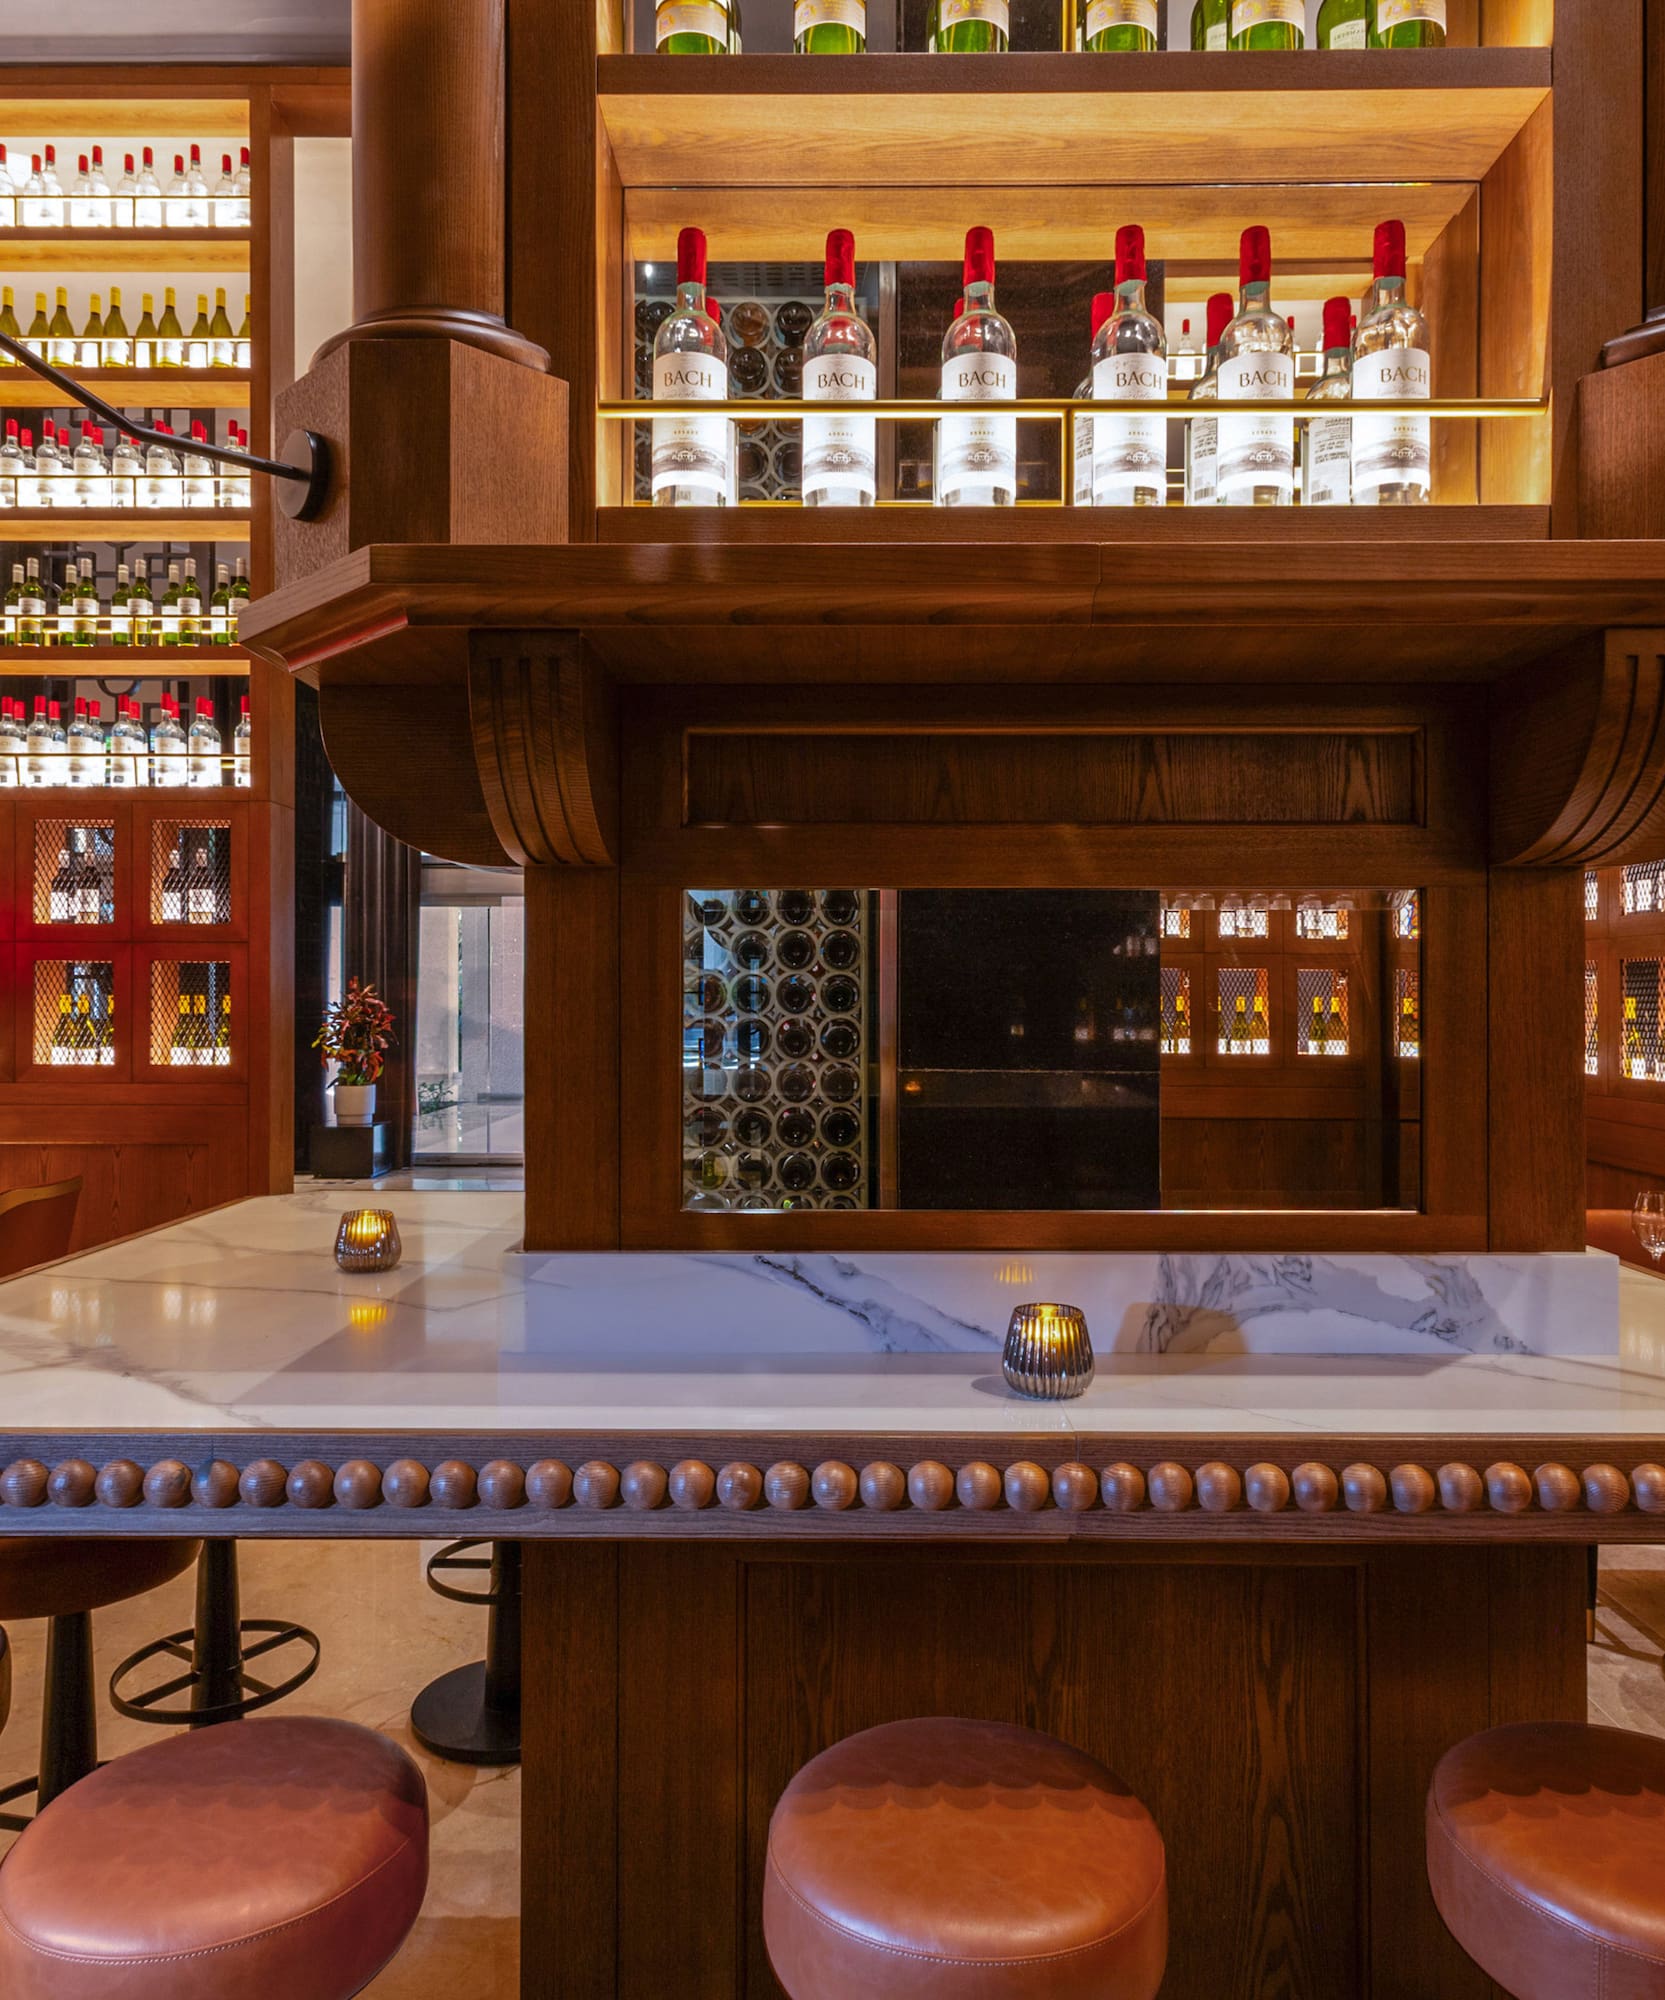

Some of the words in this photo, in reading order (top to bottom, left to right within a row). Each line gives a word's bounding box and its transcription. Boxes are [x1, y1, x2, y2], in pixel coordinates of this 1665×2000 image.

[664, 370, 711, 388] BACH
[818, 371, 865, 389] BACH
[959, 370, 1006, 389] BACH
[1115, 371, 1162, 389] BACH
[1239, 371, 1287, 389] BACH
[1380, 366, 1426, 385] BACH
